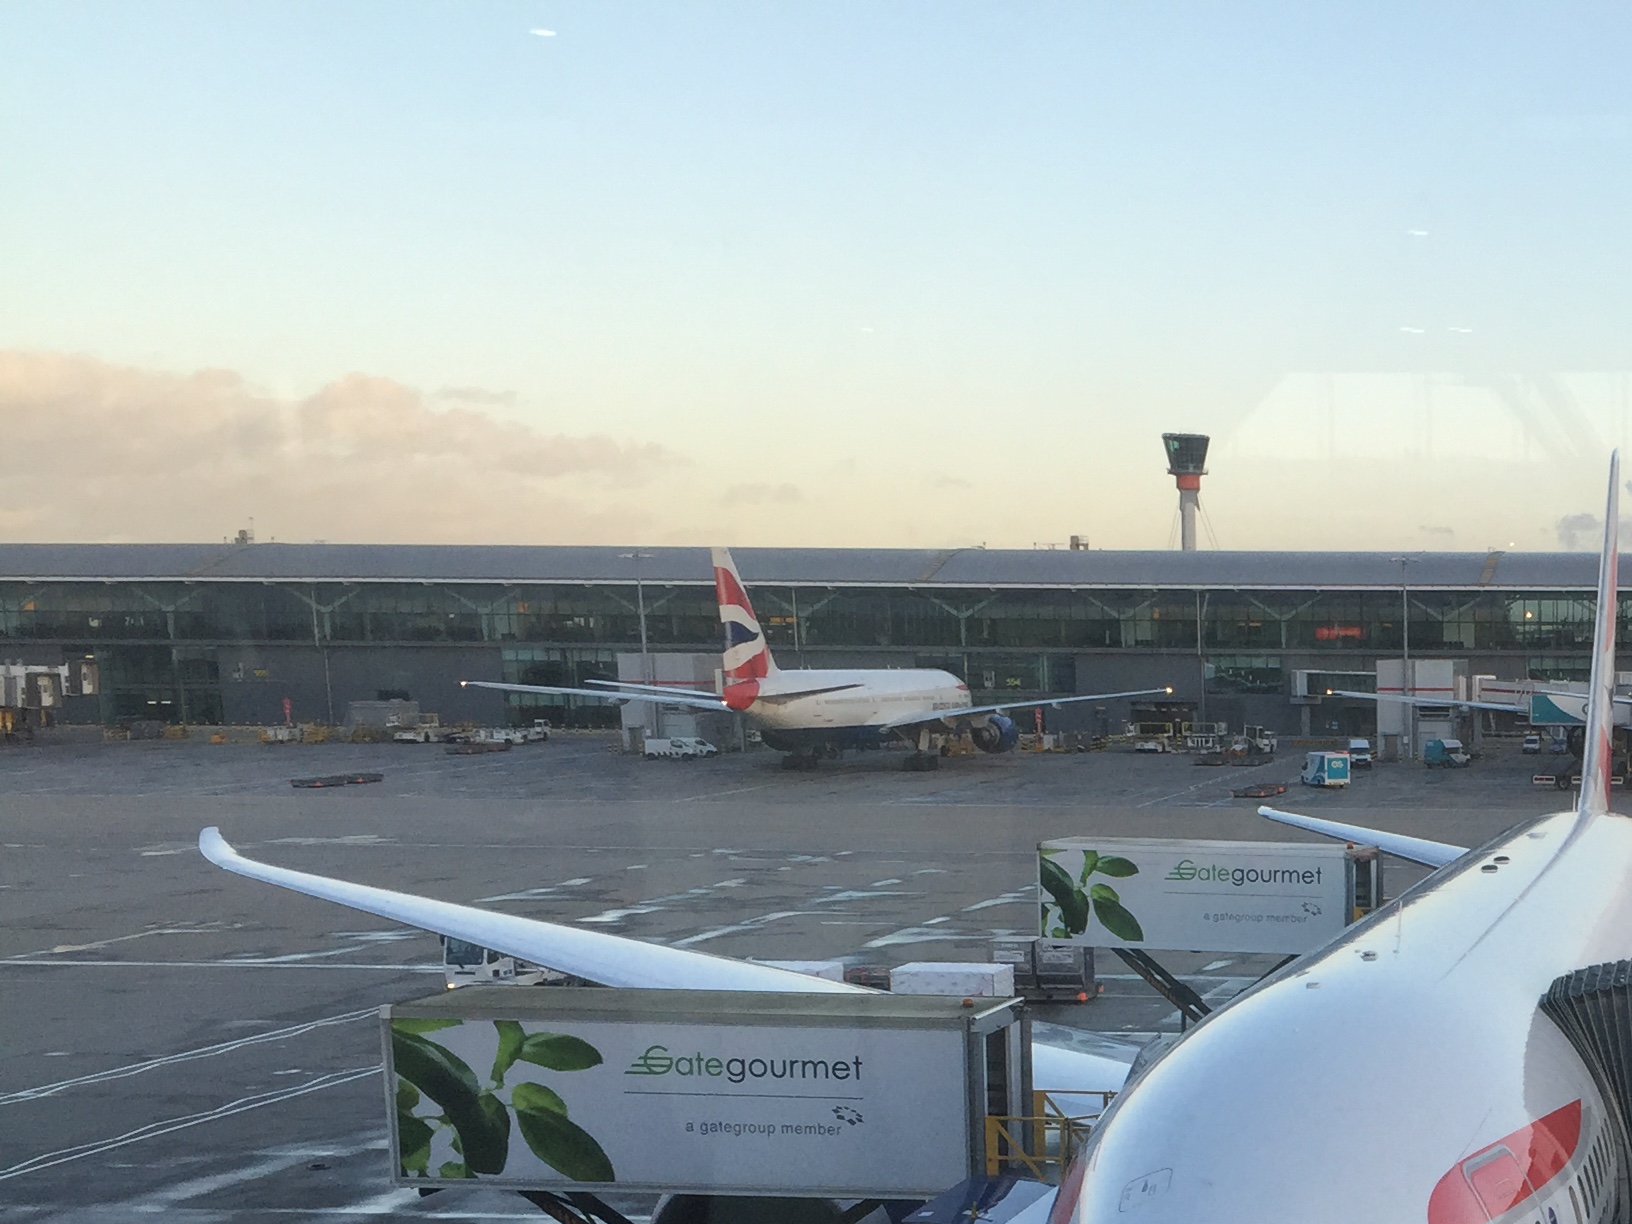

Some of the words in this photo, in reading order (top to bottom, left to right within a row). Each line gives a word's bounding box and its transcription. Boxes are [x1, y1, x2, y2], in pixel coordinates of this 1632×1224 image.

[1164, 859, 1323, 887] Gategourmet
[1212, 913, 1264, 924] gategroup
[623, 1045, 864, 1084] Gategourmet
[685, 1121, 695, 1133] a
[699, 1120, 776, 1137] gategroup
[781, 1122, 843, 1137] member
